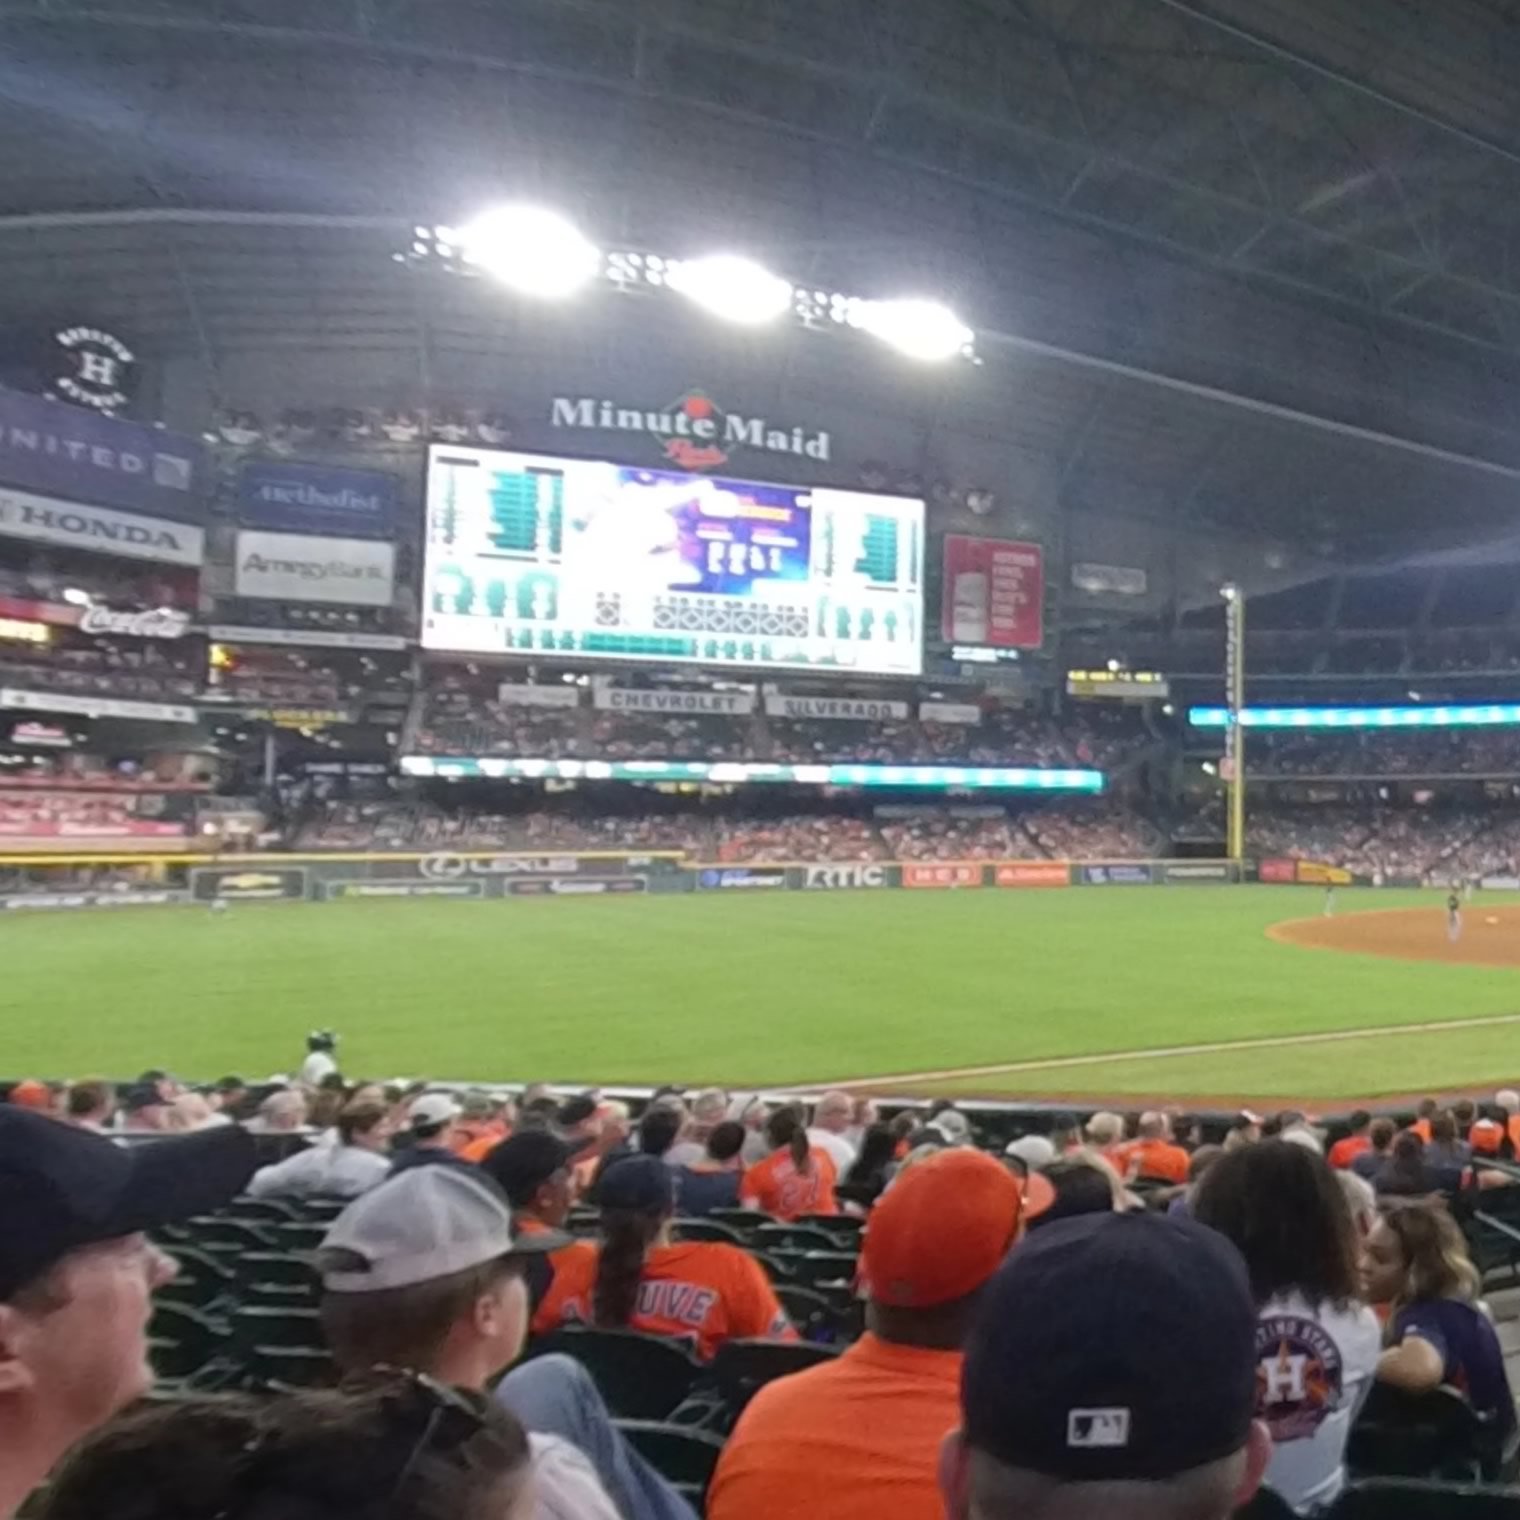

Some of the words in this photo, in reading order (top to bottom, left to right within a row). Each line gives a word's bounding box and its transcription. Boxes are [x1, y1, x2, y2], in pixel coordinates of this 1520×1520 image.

[0, 426, 144, 473] NITED
[551, 397, 716, 440] Minute
[723, 413, 831, 461] Maid
[21, 505, 182, 551] HONDA
[610, 691, 735, 710] CHEVROLET
[1263, 1354, 1308, 1403] H
